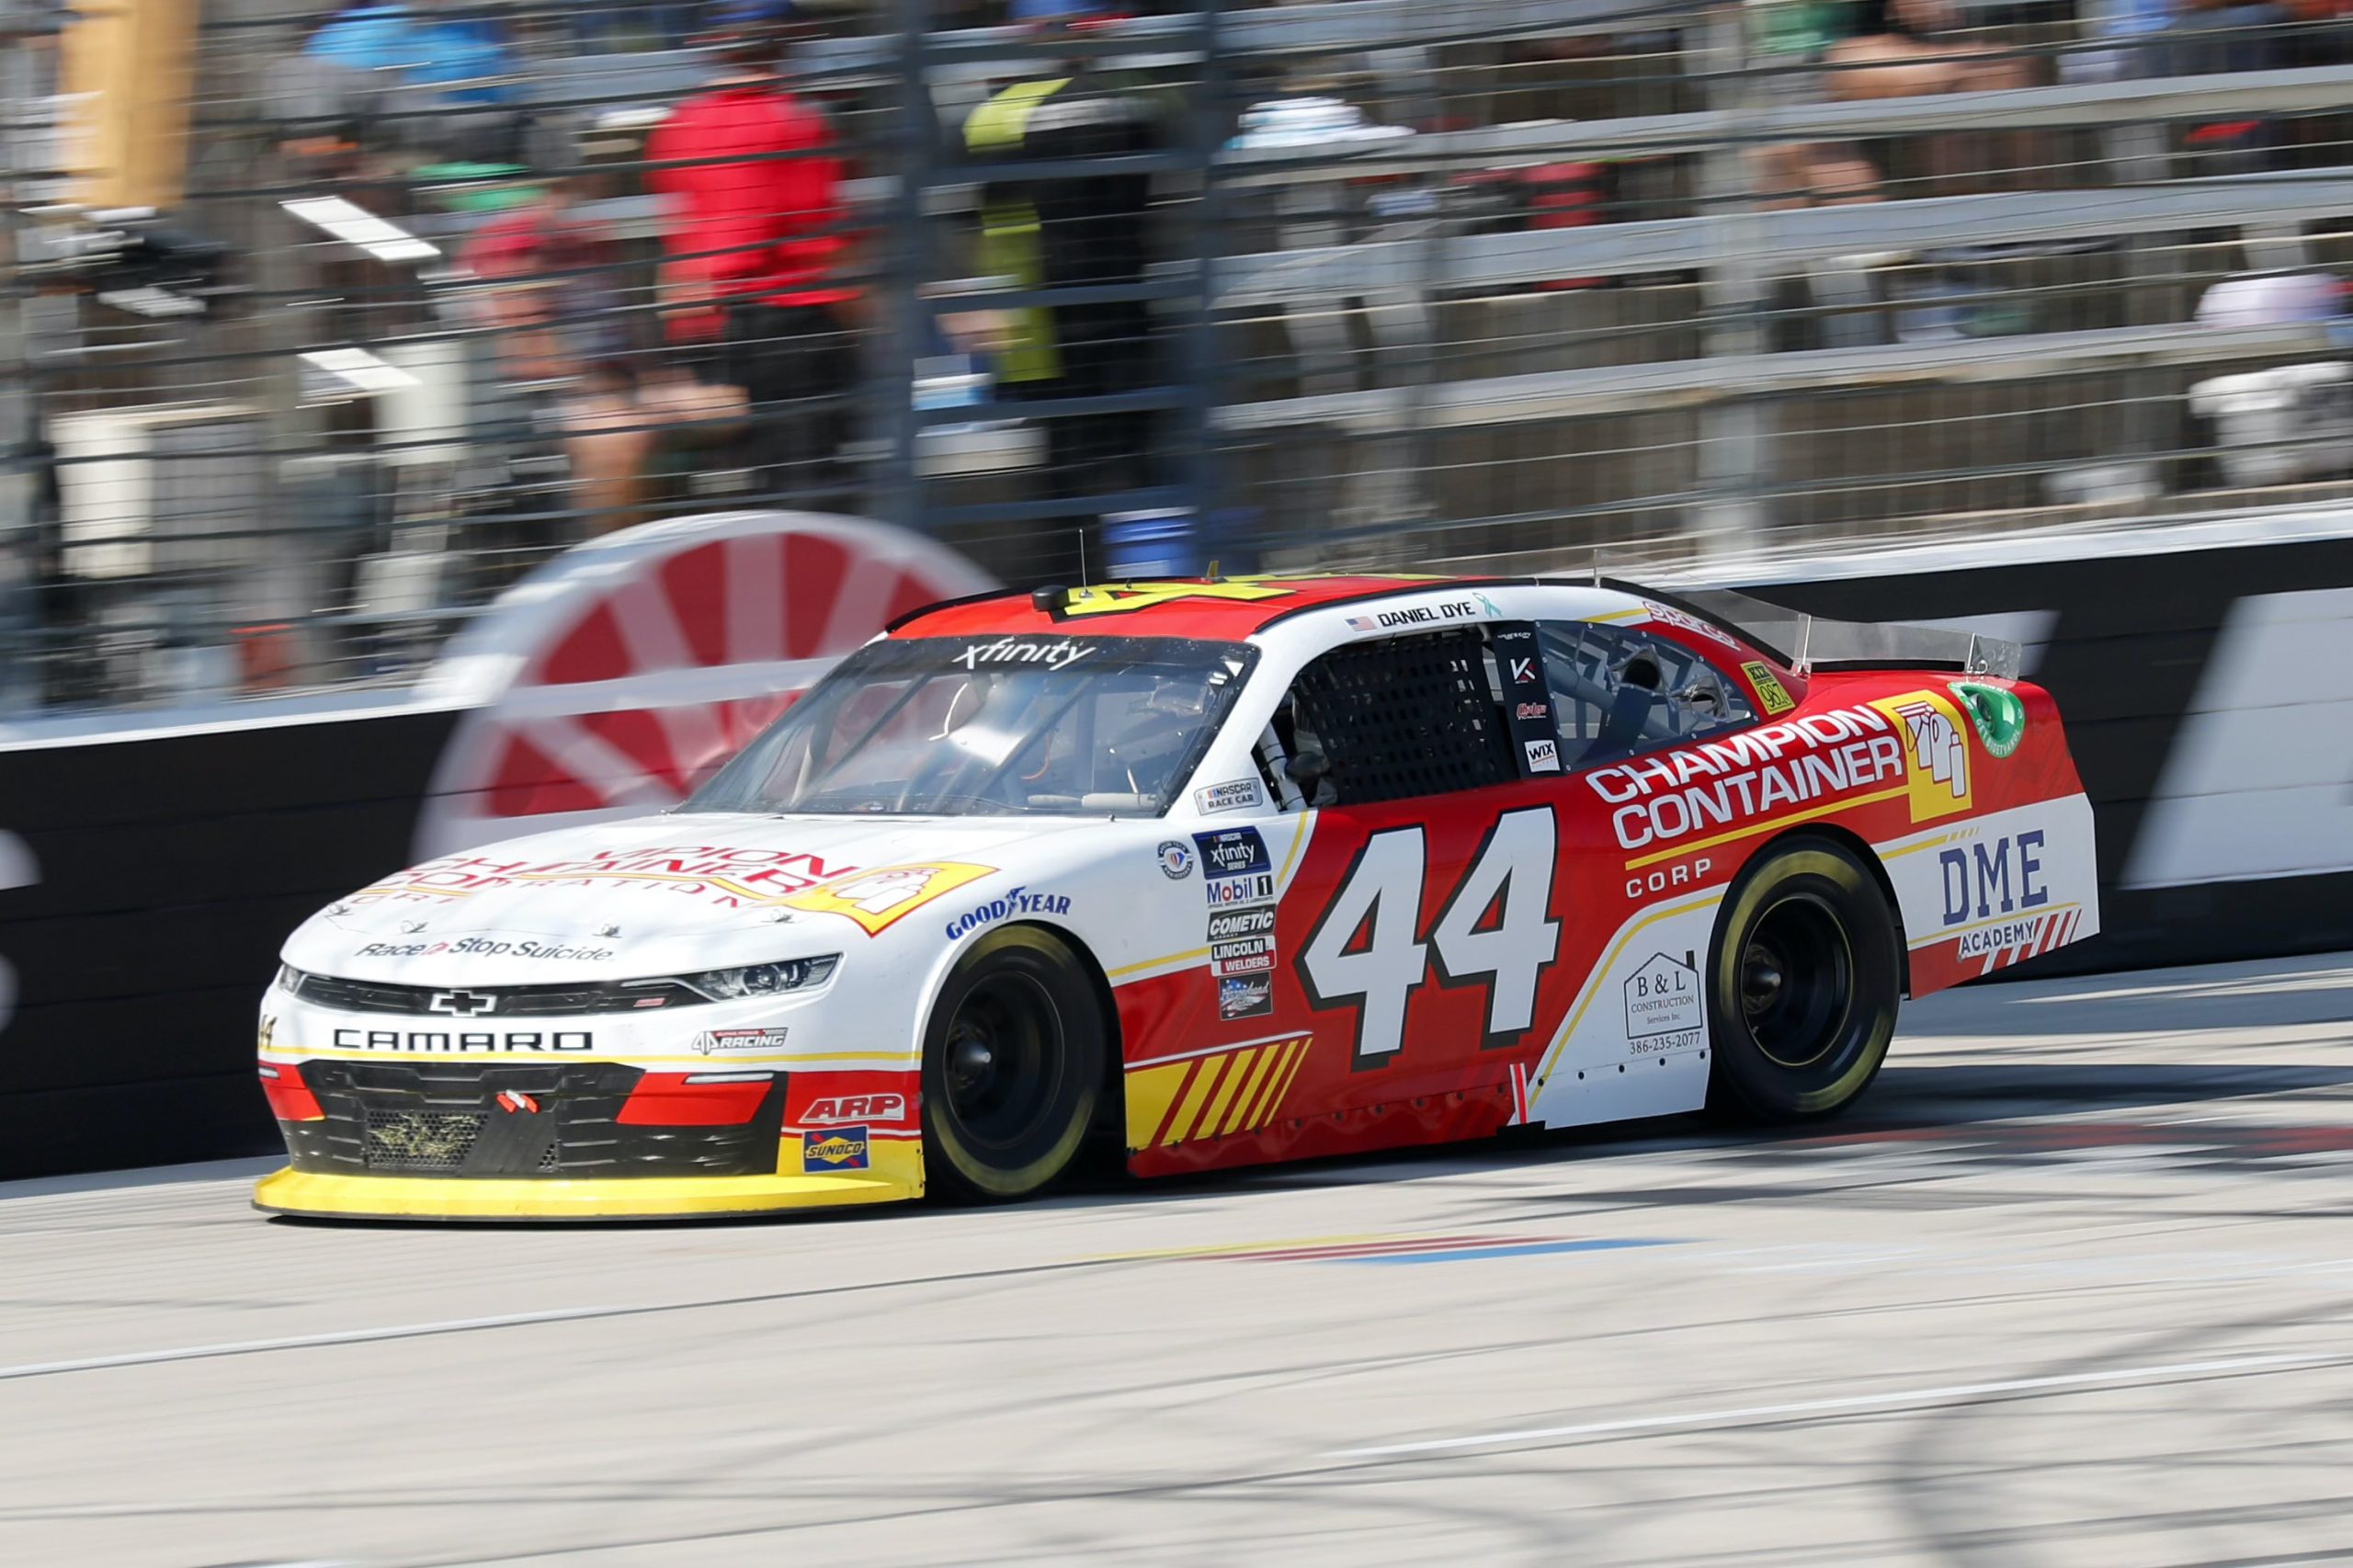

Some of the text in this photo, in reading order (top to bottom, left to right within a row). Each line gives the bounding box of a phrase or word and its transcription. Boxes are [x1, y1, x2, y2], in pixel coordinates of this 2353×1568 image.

[1378, 601, 1476, 630] DANIEL DYE
[952, 636, 1097, 671] xfinity
[1528, 743, 1554, 760] WIX
[1585, 704, 1889, 804] CHAMPION
[1208, 793, 1255, 809] RACE CAR
[1215, 782, 1253, 798] NASCAR
[1611, 735, 1903, 850] CONTAINER
[1210, 842, 1255, 867] xfinity
[1624, 857, 1712, 899] CORP
[1938, 829, 2049, 926] DME
[1206, 877, 1253, 904] Mobil
[1209, 911, 1274, 937] COMETIC
[1302, 805, 1561, 1059] 44
[354, 942, 427, 958] Race
[449, 937, 512, 958] Stop
[511, 940, 614, 962] Suicide
[1213, 940, 1264, 960] LINCOLN
[1960, 920, 2036, 956] ACADEMY
[1225, 956, 1270, 971] WELDERS
[1636, 971, 1687, 997] B & L
[1631, 994, 1695, 1014] CONSTRUCTION
[333, 1028, 593, 1052] CAMARO
[720, 1035, 785, 1048] RACING
[1630, 1031, 1700, 1055] 386-235-2077
[801, 1095, 903, 1119] ARP
[808, 1142, 862, 1157] SUNOCO
